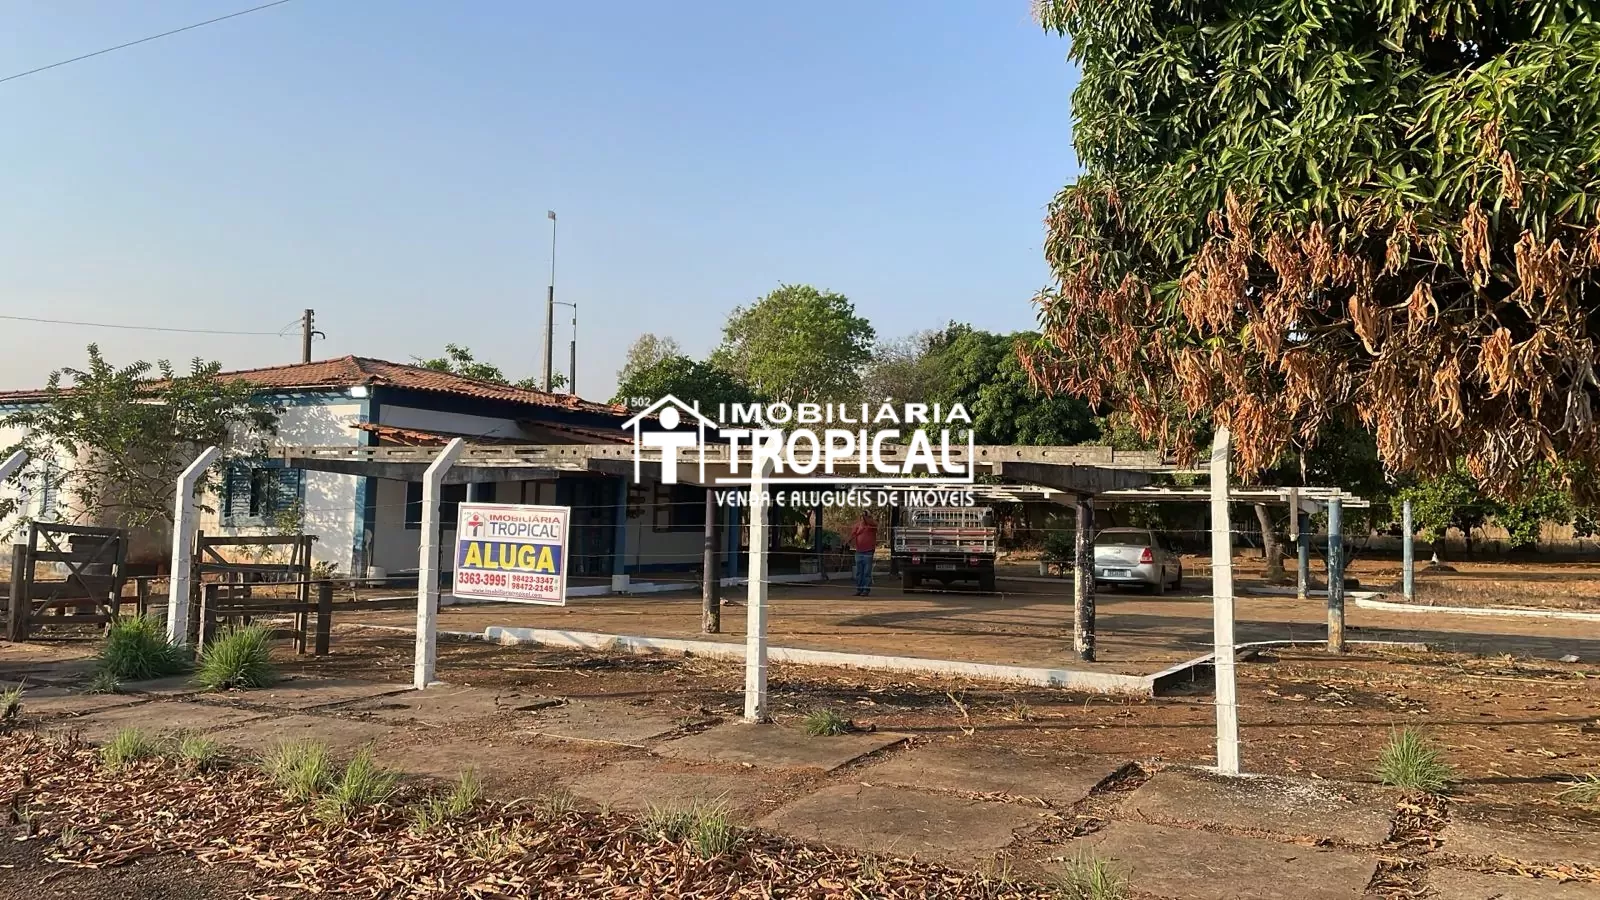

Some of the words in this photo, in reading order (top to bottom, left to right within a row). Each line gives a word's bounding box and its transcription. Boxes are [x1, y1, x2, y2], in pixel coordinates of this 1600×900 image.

[489, 514, 561, 524] IMOBILIÁRIA
[489, 521, 558, 538] TROPICAL
[463, 542, 556, 574] ALUGA
[459, 572, 507, 587] 3363-3995
[511, 575, 554, 585] 98423-3347
[511, 582, 554, 592] 98472-2145
